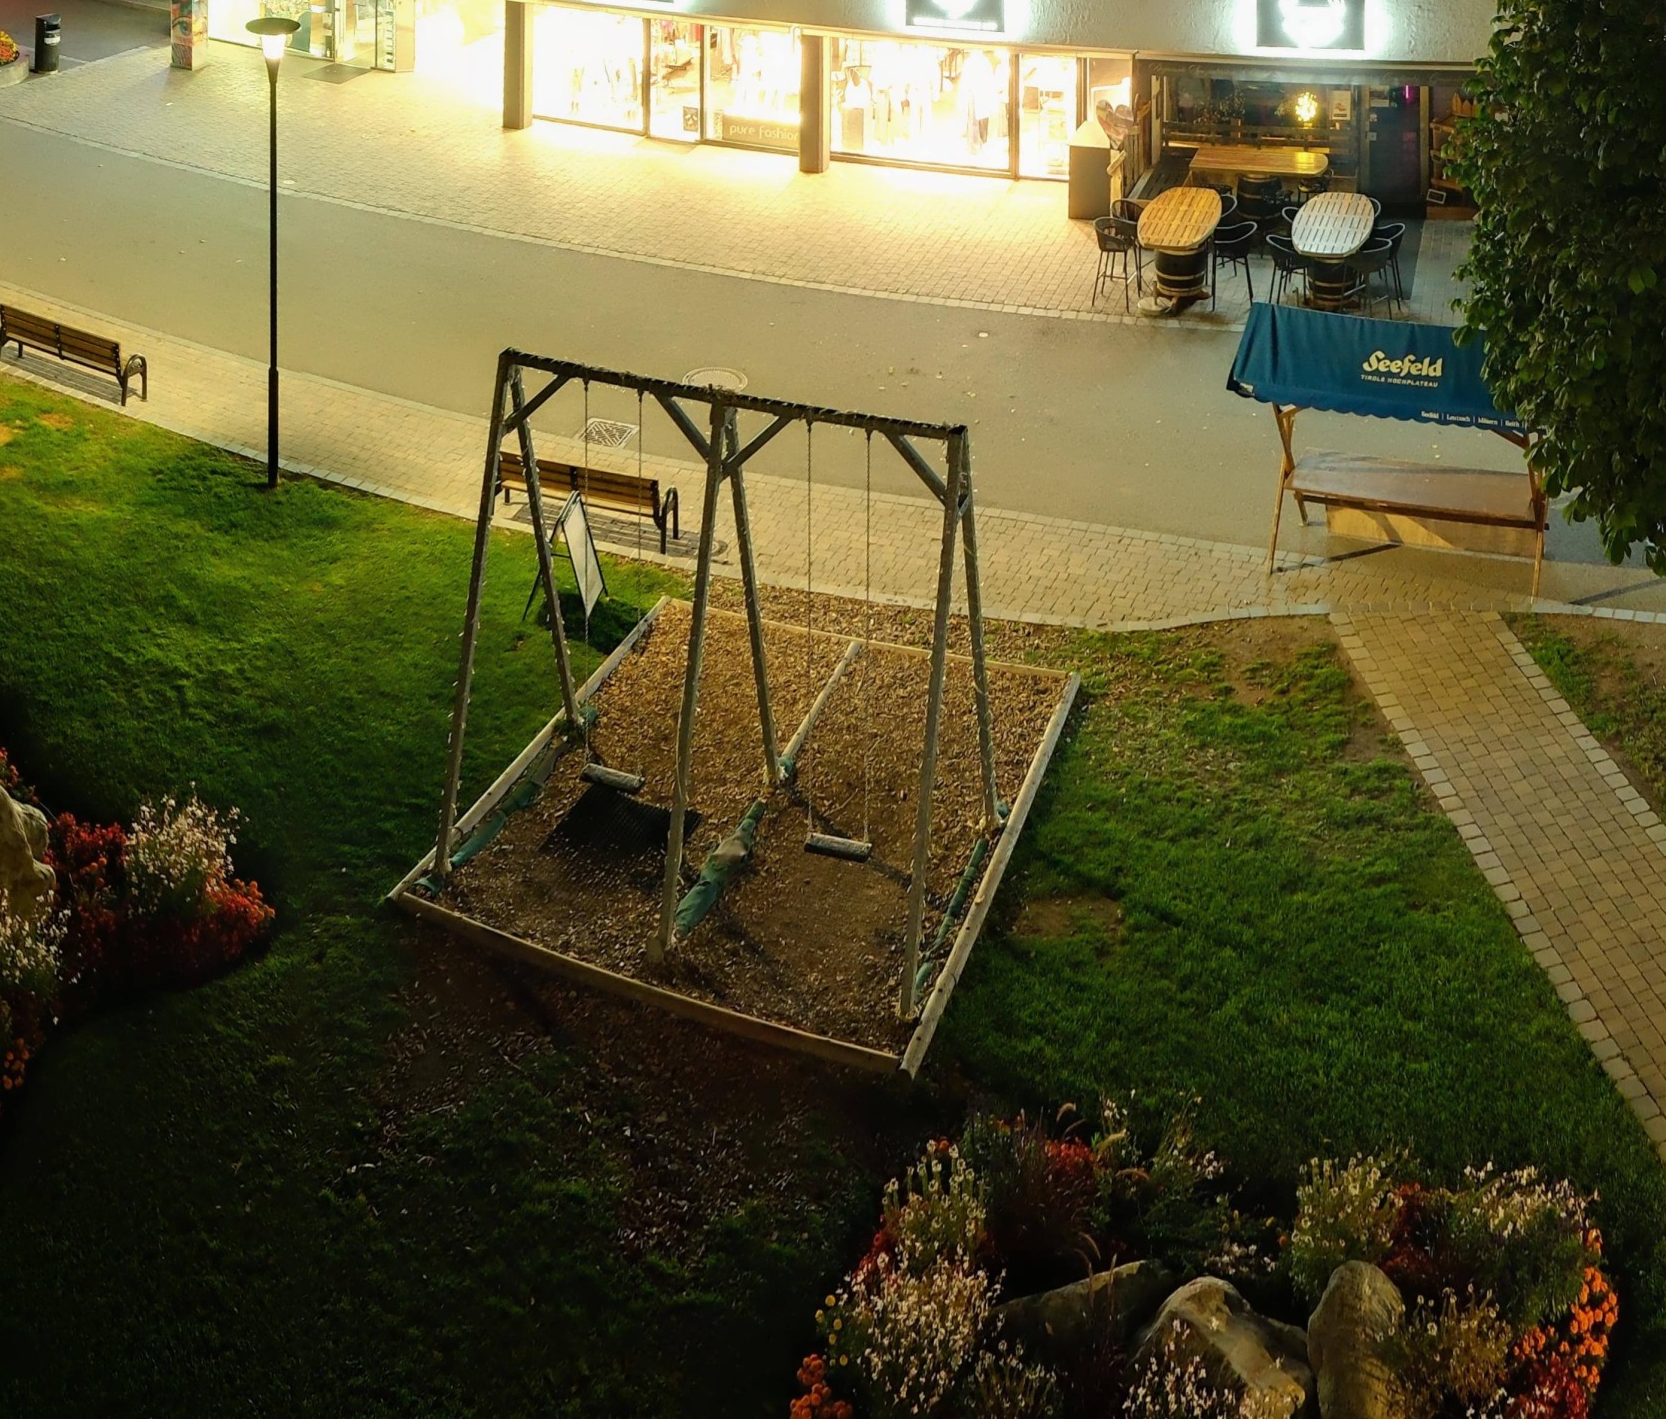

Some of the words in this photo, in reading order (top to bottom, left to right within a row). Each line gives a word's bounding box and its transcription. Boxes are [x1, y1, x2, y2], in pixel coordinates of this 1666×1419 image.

[730, 125, 755, 136] pure
[1362, 350, 1443, 378] Seefeld
[1361, 374, 1385, 382] TIROLS
[1388, 377, 1438, 387] HOCHPLATEAU
